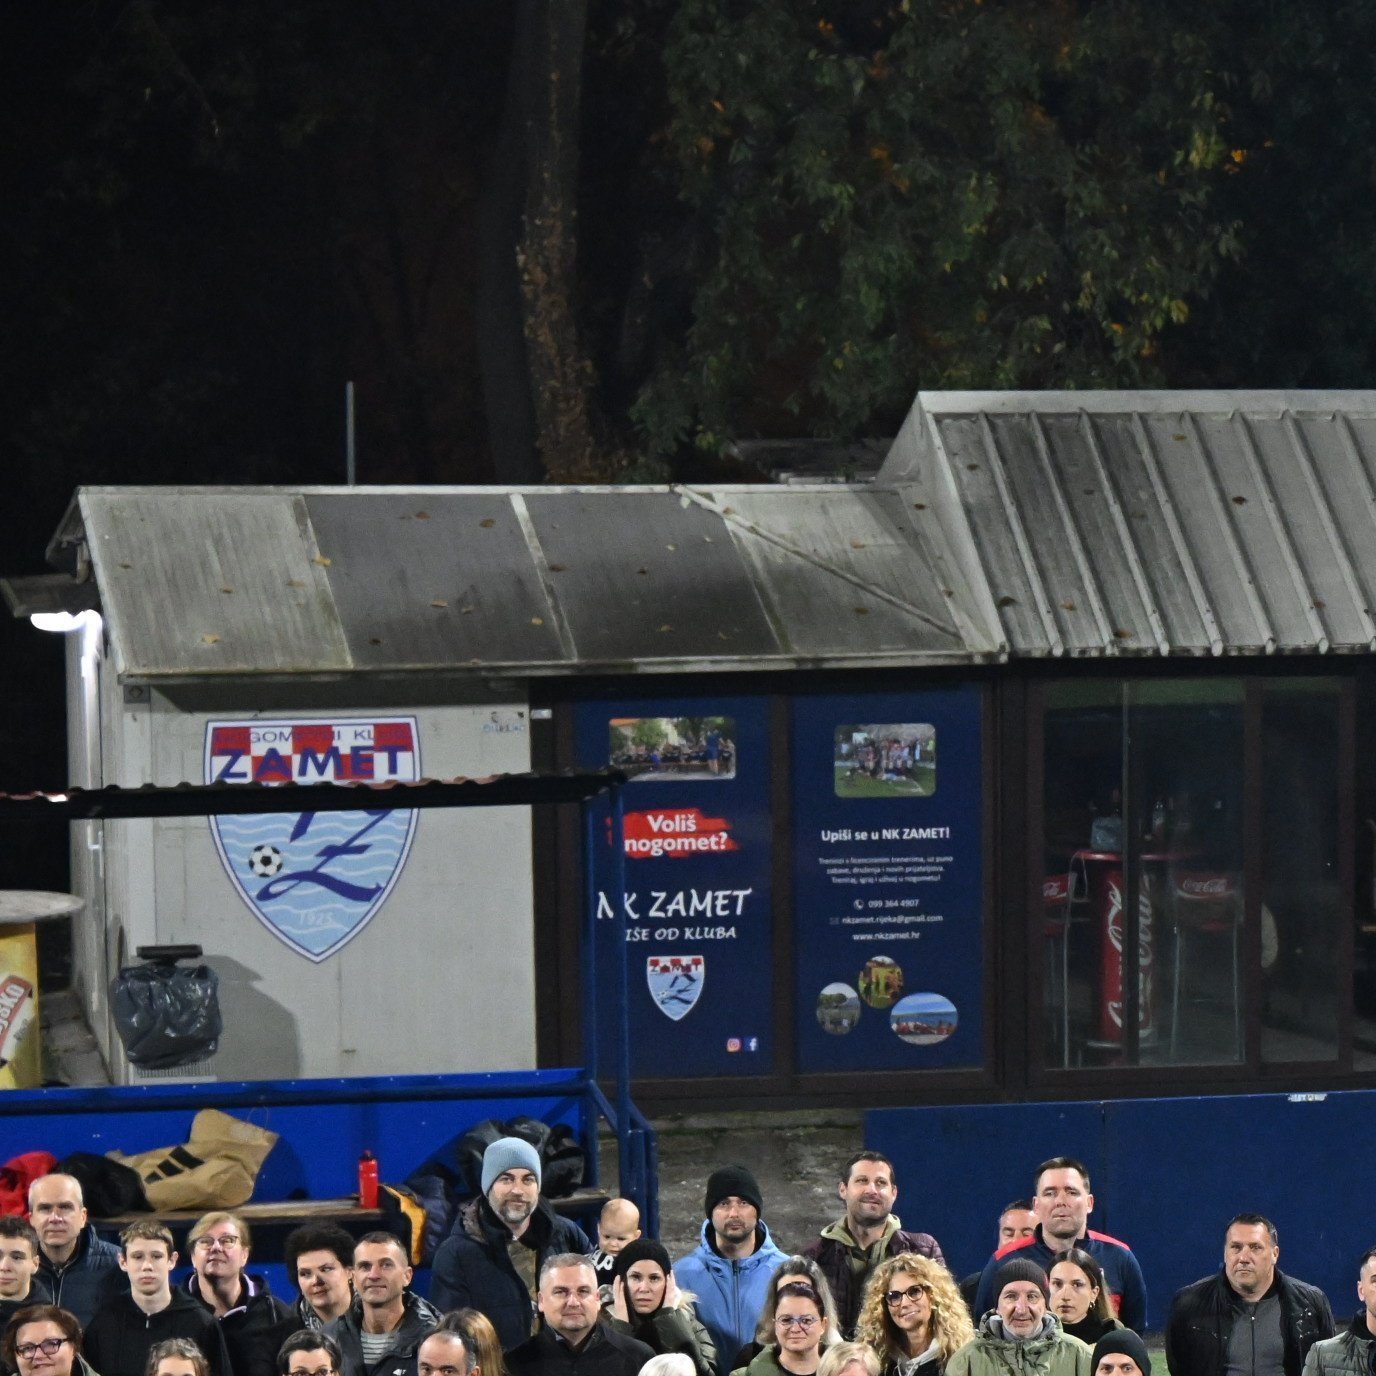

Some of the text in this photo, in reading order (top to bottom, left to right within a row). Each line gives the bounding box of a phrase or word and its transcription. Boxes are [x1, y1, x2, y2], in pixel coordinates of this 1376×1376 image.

[216, 745, 407, 779] ZAMET
[647, 813, 697, 832] Voliš
[624, 831, 728, 856] nogomet?
[821, 826, 950, 842] Upiši se u NK ZAMET!
[648, 887, 753, 918] ZAMET
[621, 925, 737, 942] IŠE OD KLUBA
